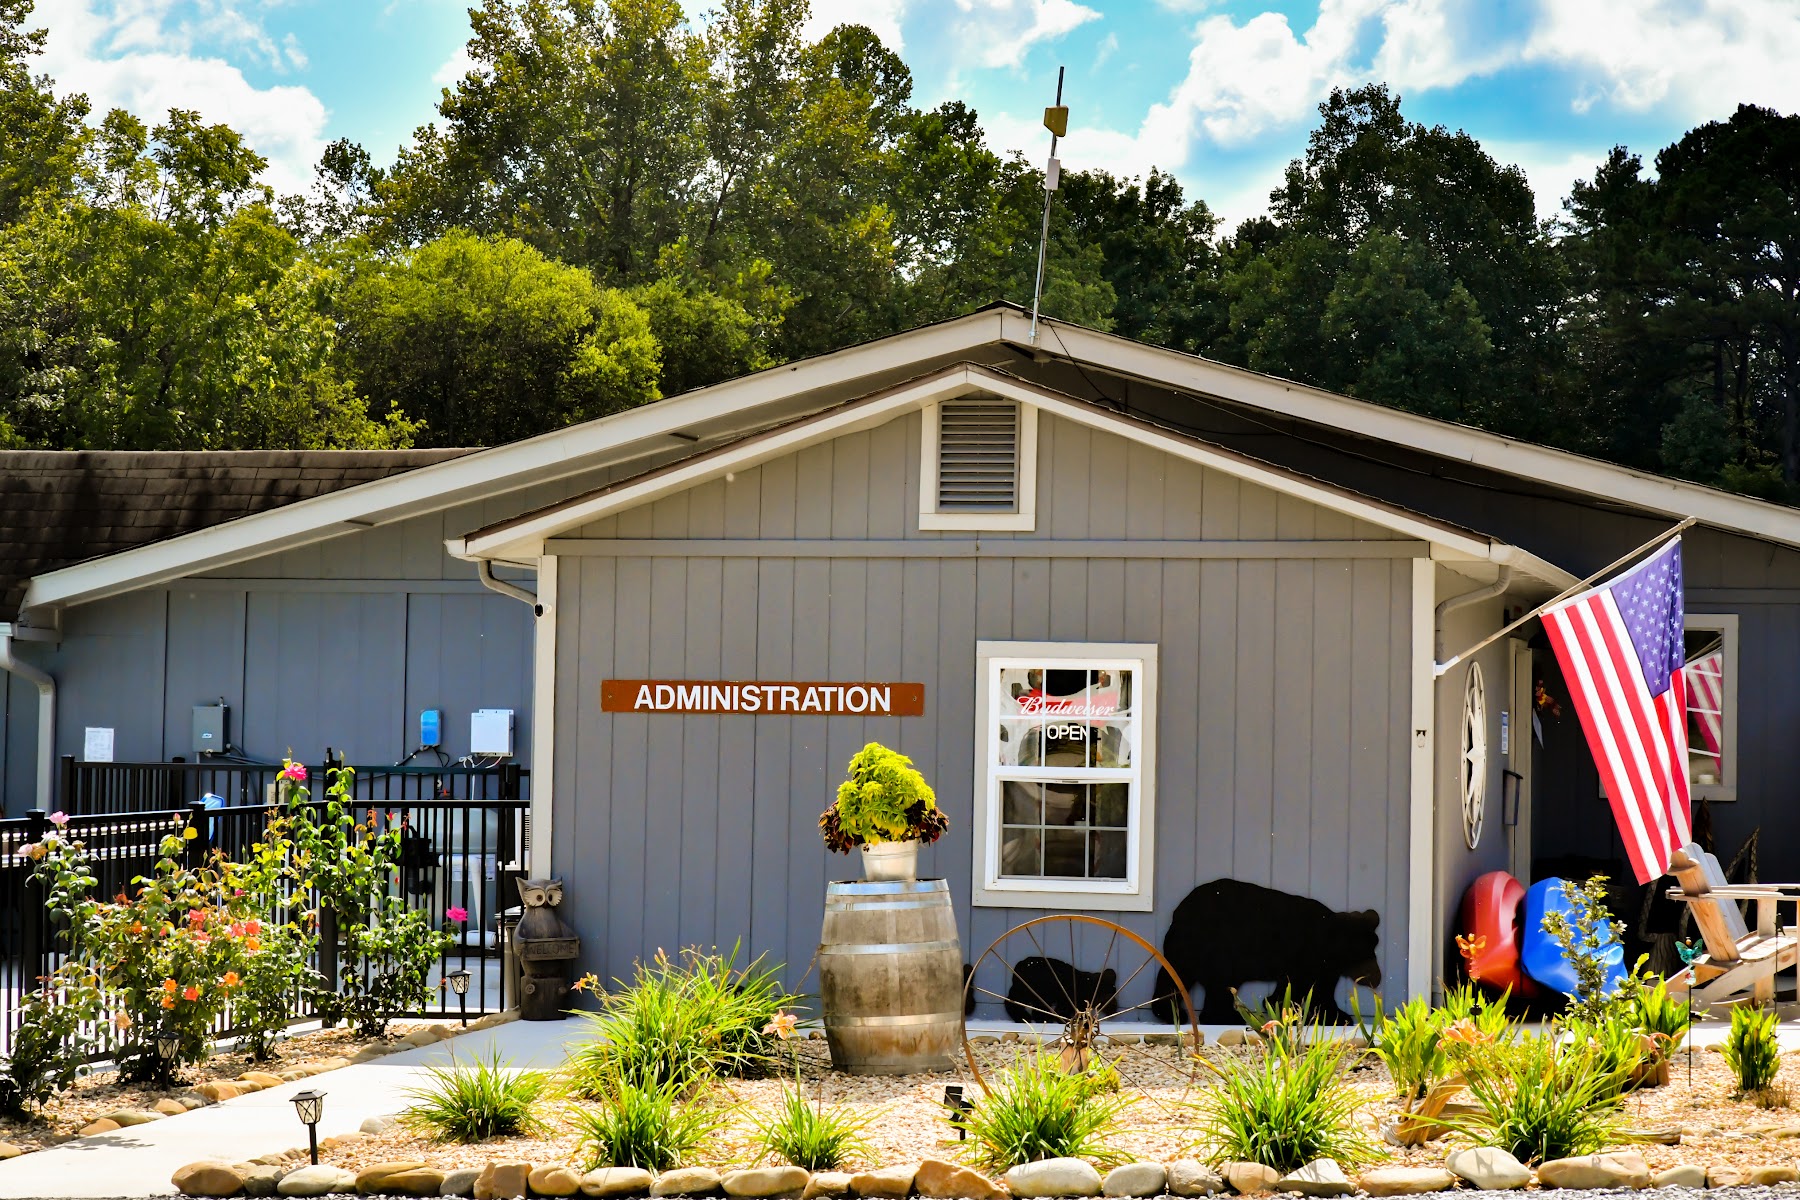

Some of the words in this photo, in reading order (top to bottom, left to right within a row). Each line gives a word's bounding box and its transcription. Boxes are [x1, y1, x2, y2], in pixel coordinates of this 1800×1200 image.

[634, 684, 892, 713] ADMINISTRATION
[1016, 696, 1115, 717] Budweiser
[1046, 724, 1088, 741] OPEN
